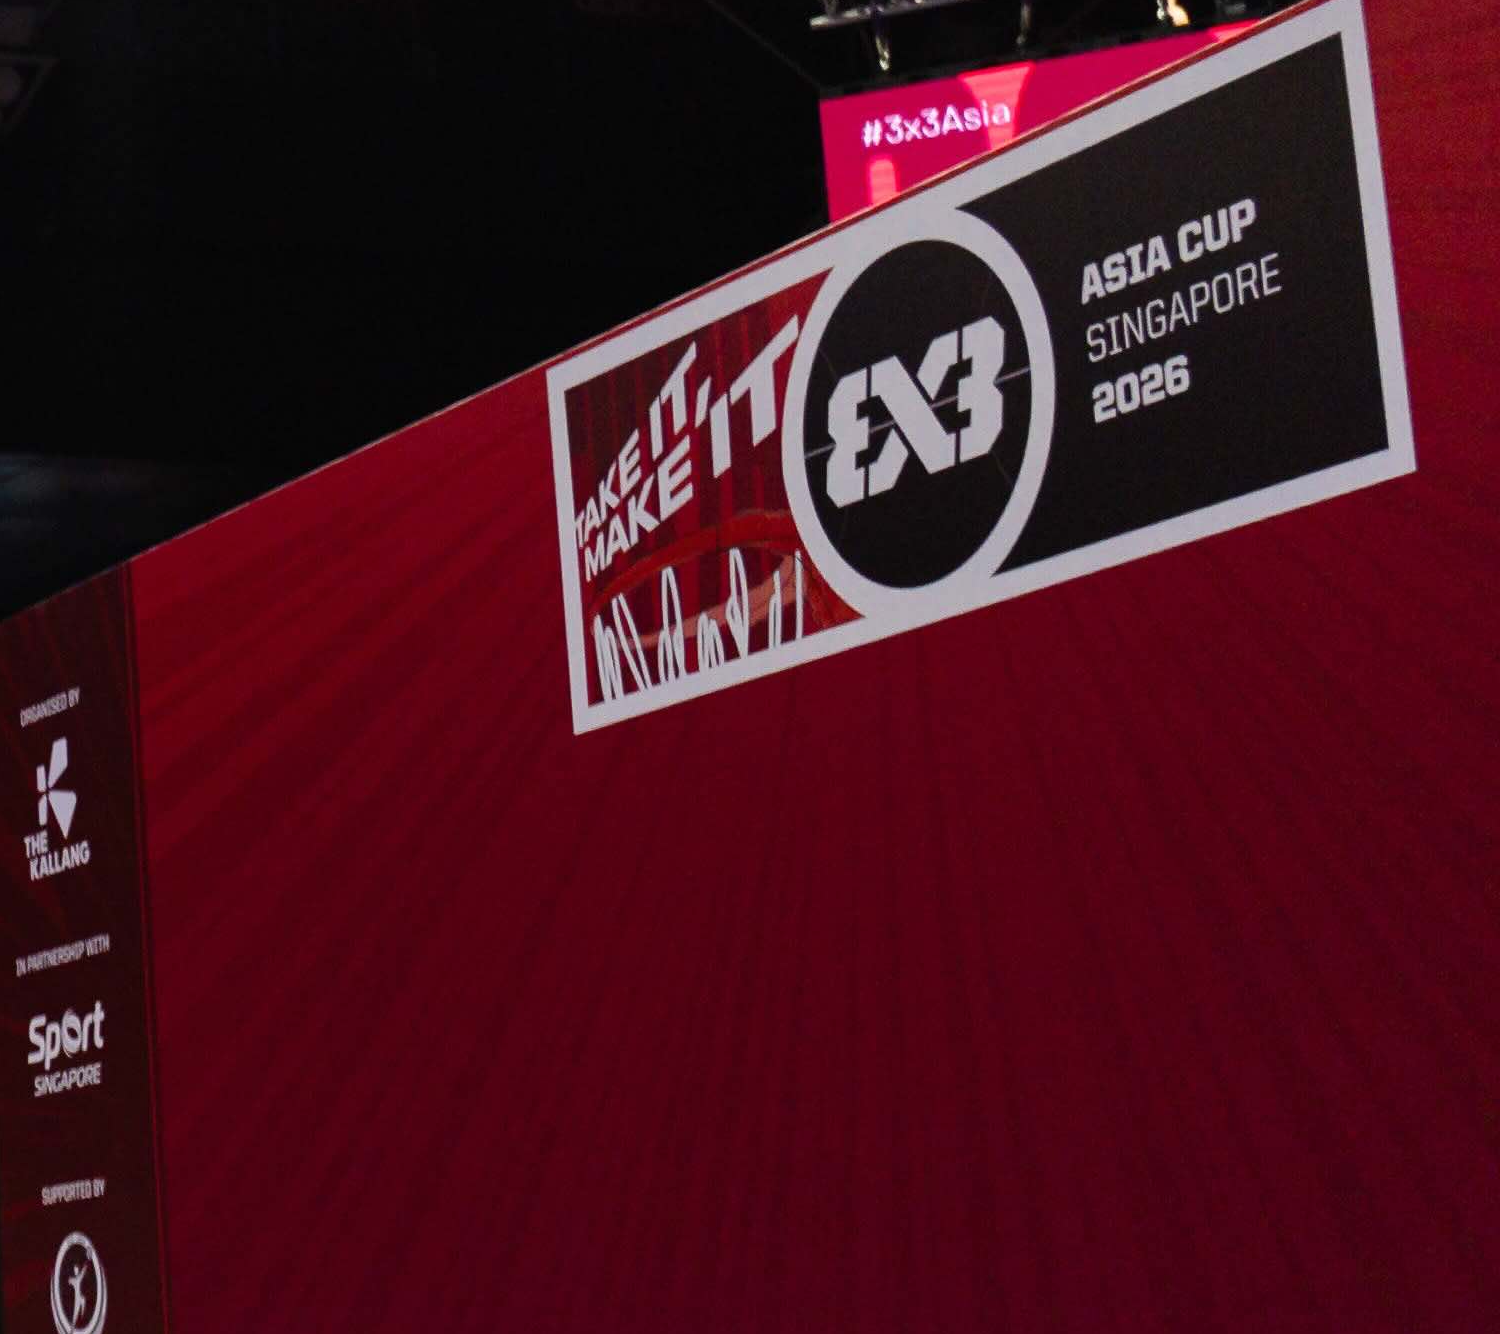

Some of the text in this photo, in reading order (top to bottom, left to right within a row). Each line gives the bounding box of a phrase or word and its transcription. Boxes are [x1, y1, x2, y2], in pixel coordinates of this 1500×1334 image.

[861, 101, 1012, 148] #3x3Asia
[1081, 198, 1257, 304] ASIA CUP
[1086, 253, 1282, 364] SINGAPORE
[1093, 354, 1191, 424] 2026
[584, 314, 799, 583] MAKE IT
[574, 428, 642, 548] TAKE
[23, 829, 49, 859] THE
[30, 840, 90, 881] KALLANG
[27, 1000, 105, 1071] Sport
[34, 1061, 102, 1097] SINGAPORE
